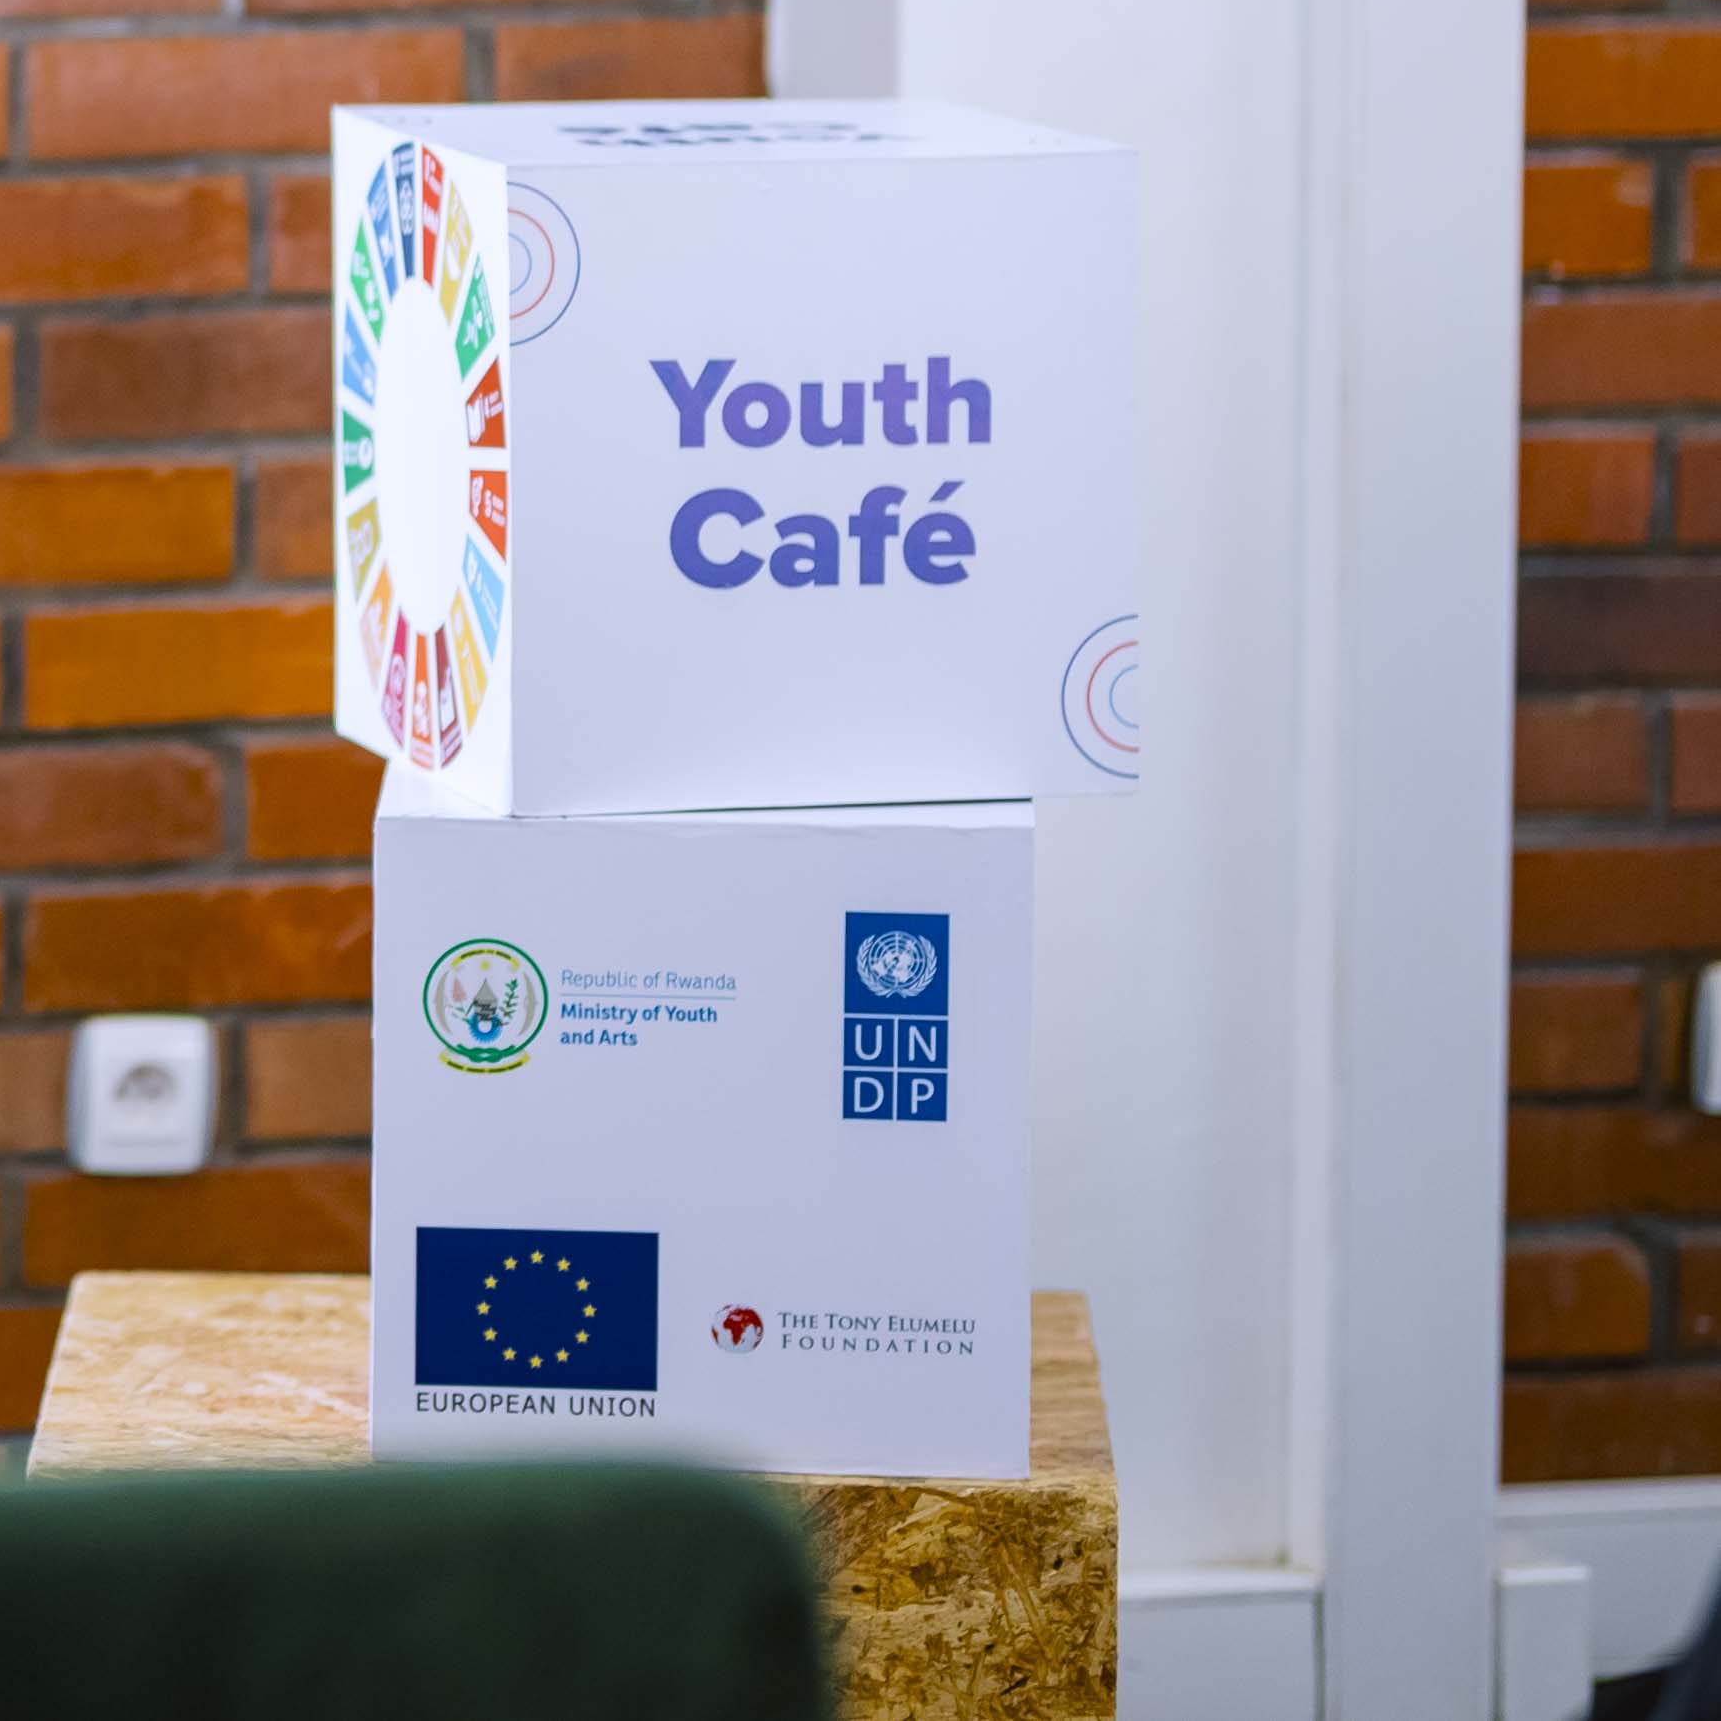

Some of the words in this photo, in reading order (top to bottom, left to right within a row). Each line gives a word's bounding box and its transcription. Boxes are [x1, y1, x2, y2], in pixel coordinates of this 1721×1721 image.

[649, 356, 992, 449] Youth
[669, 481, 977, 590] Café
[560, 969, 638, 989] Republic
[642, 971, 661, 989] of
[665, 972, 737, 991] Rwanda
[560, 1003, 638, 1025] Ministry
[642, 1005, 661, 1021] of
[664, 1005, 718, 1023] Youth
[560, 1029, 595, 1045] and
[598, 1029, 638, 1047] Arts
[777, 1312, 819, 1329] THE
[824, 1313, 882, 1331] TONY
[888, 1315, 976, 1334] ELUMELU
[781, 1333, 973, 1355] FOUNDATION
[416, 1391, 556, 1415] EUROPEAN
[569, 1395, 656, 1418] UNION
